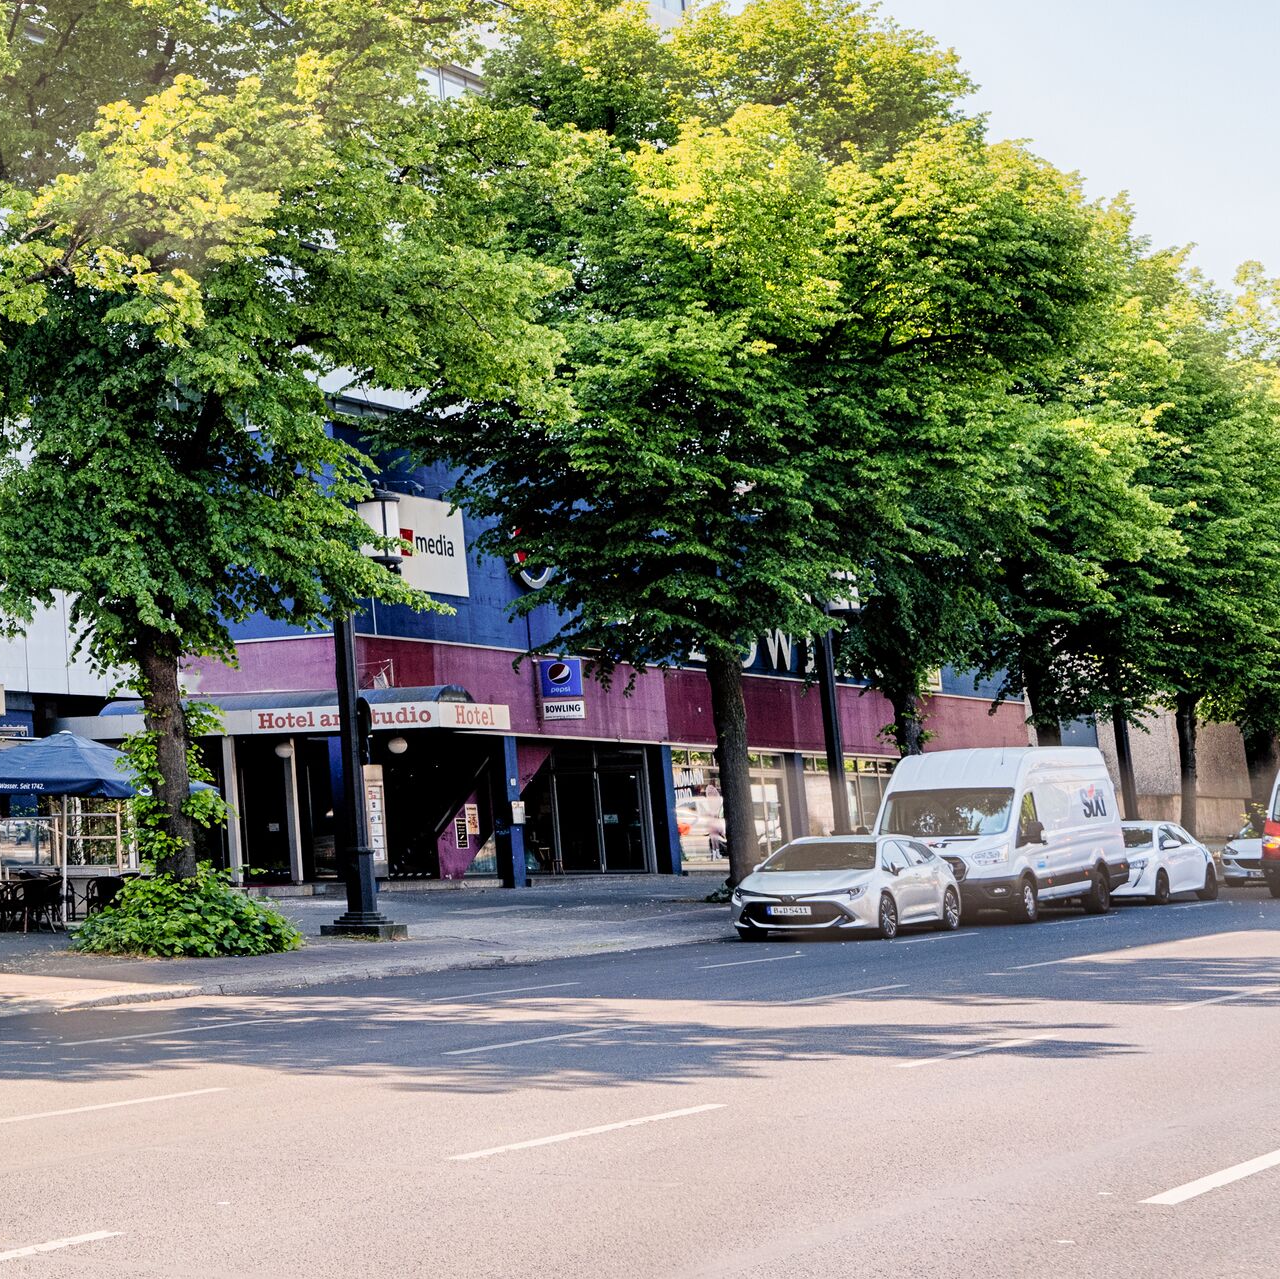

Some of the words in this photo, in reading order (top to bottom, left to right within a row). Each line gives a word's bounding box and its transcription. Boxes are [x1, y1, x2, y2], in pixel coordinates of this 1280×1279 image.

[415, 534, 455, 557] media
[258, 711, 315, 729] Hotel
[371, 706, 432, 725] tudio
[455, 705, 496, 726] Hotel
[545, 704, 581, 713] BOWLING
